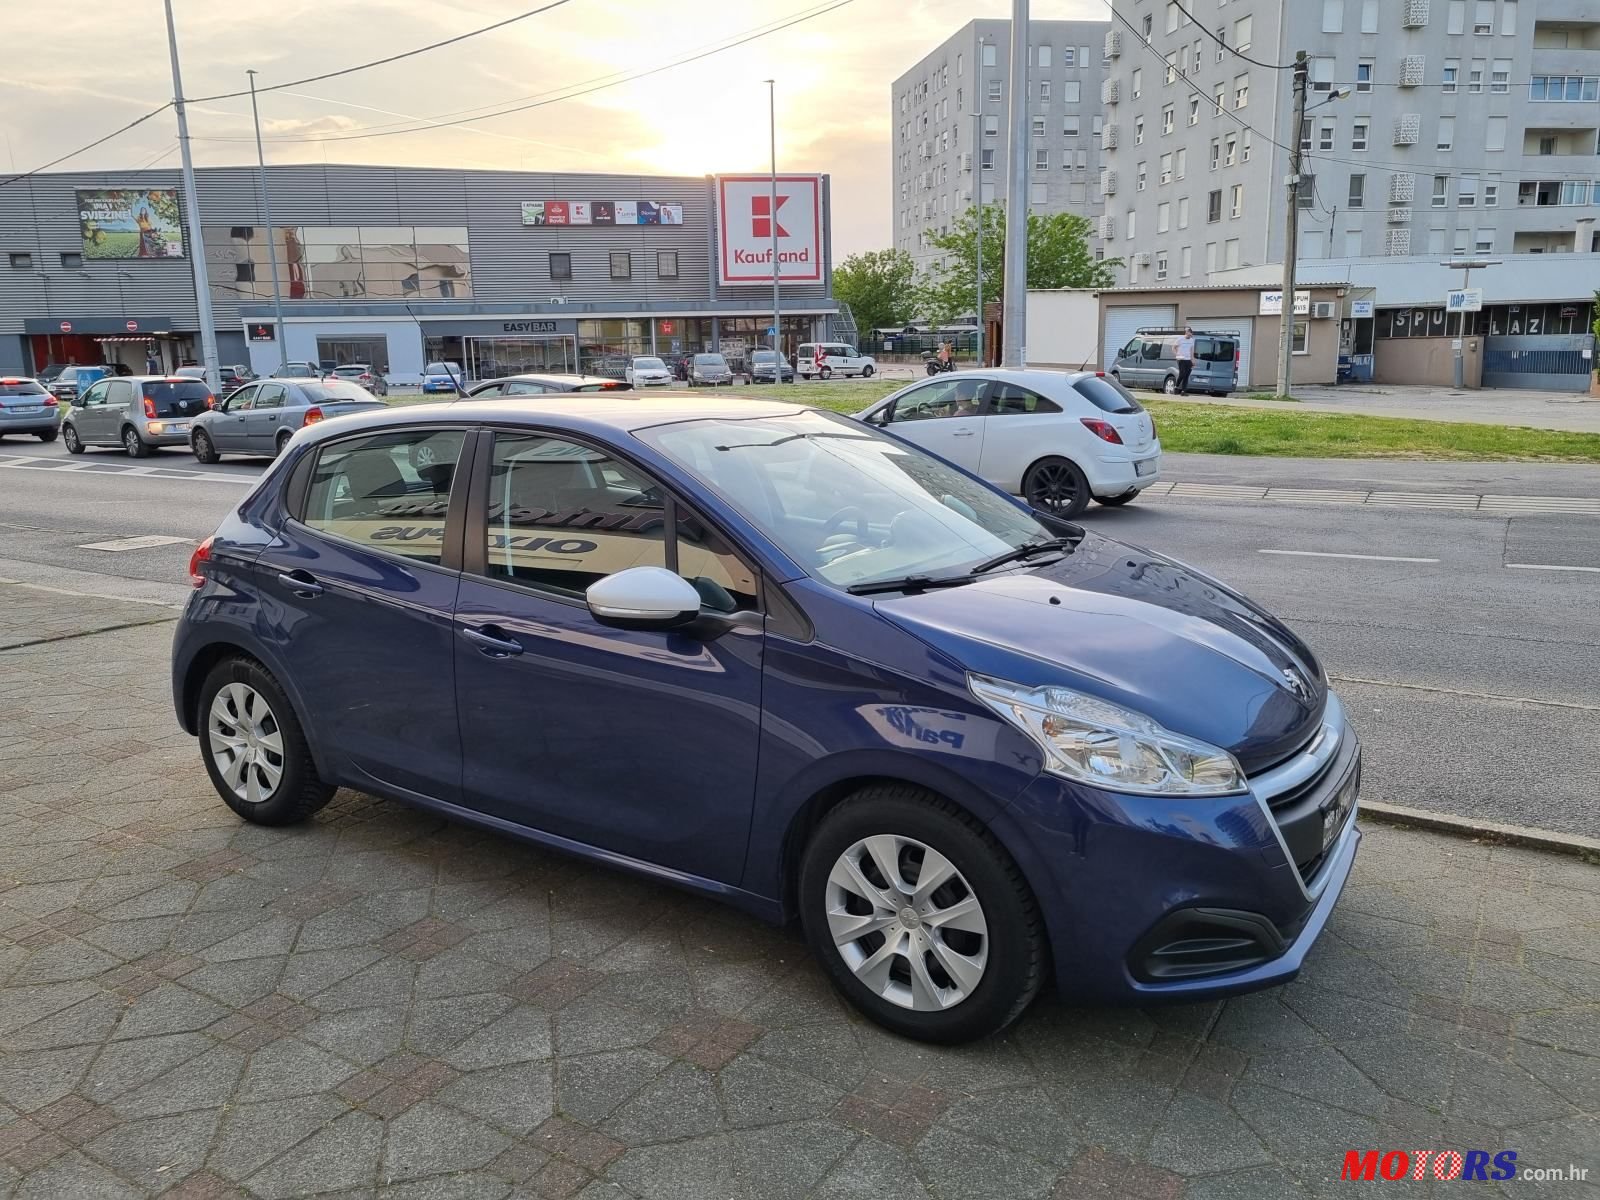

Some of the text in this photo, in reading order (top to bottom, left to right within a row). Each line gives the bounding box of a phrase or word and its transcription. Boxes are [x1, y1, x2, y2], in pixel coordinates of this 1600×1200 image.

[734, 248, 809, 264] Kaufand
[504, 321, 556, 332] EASY BAR
